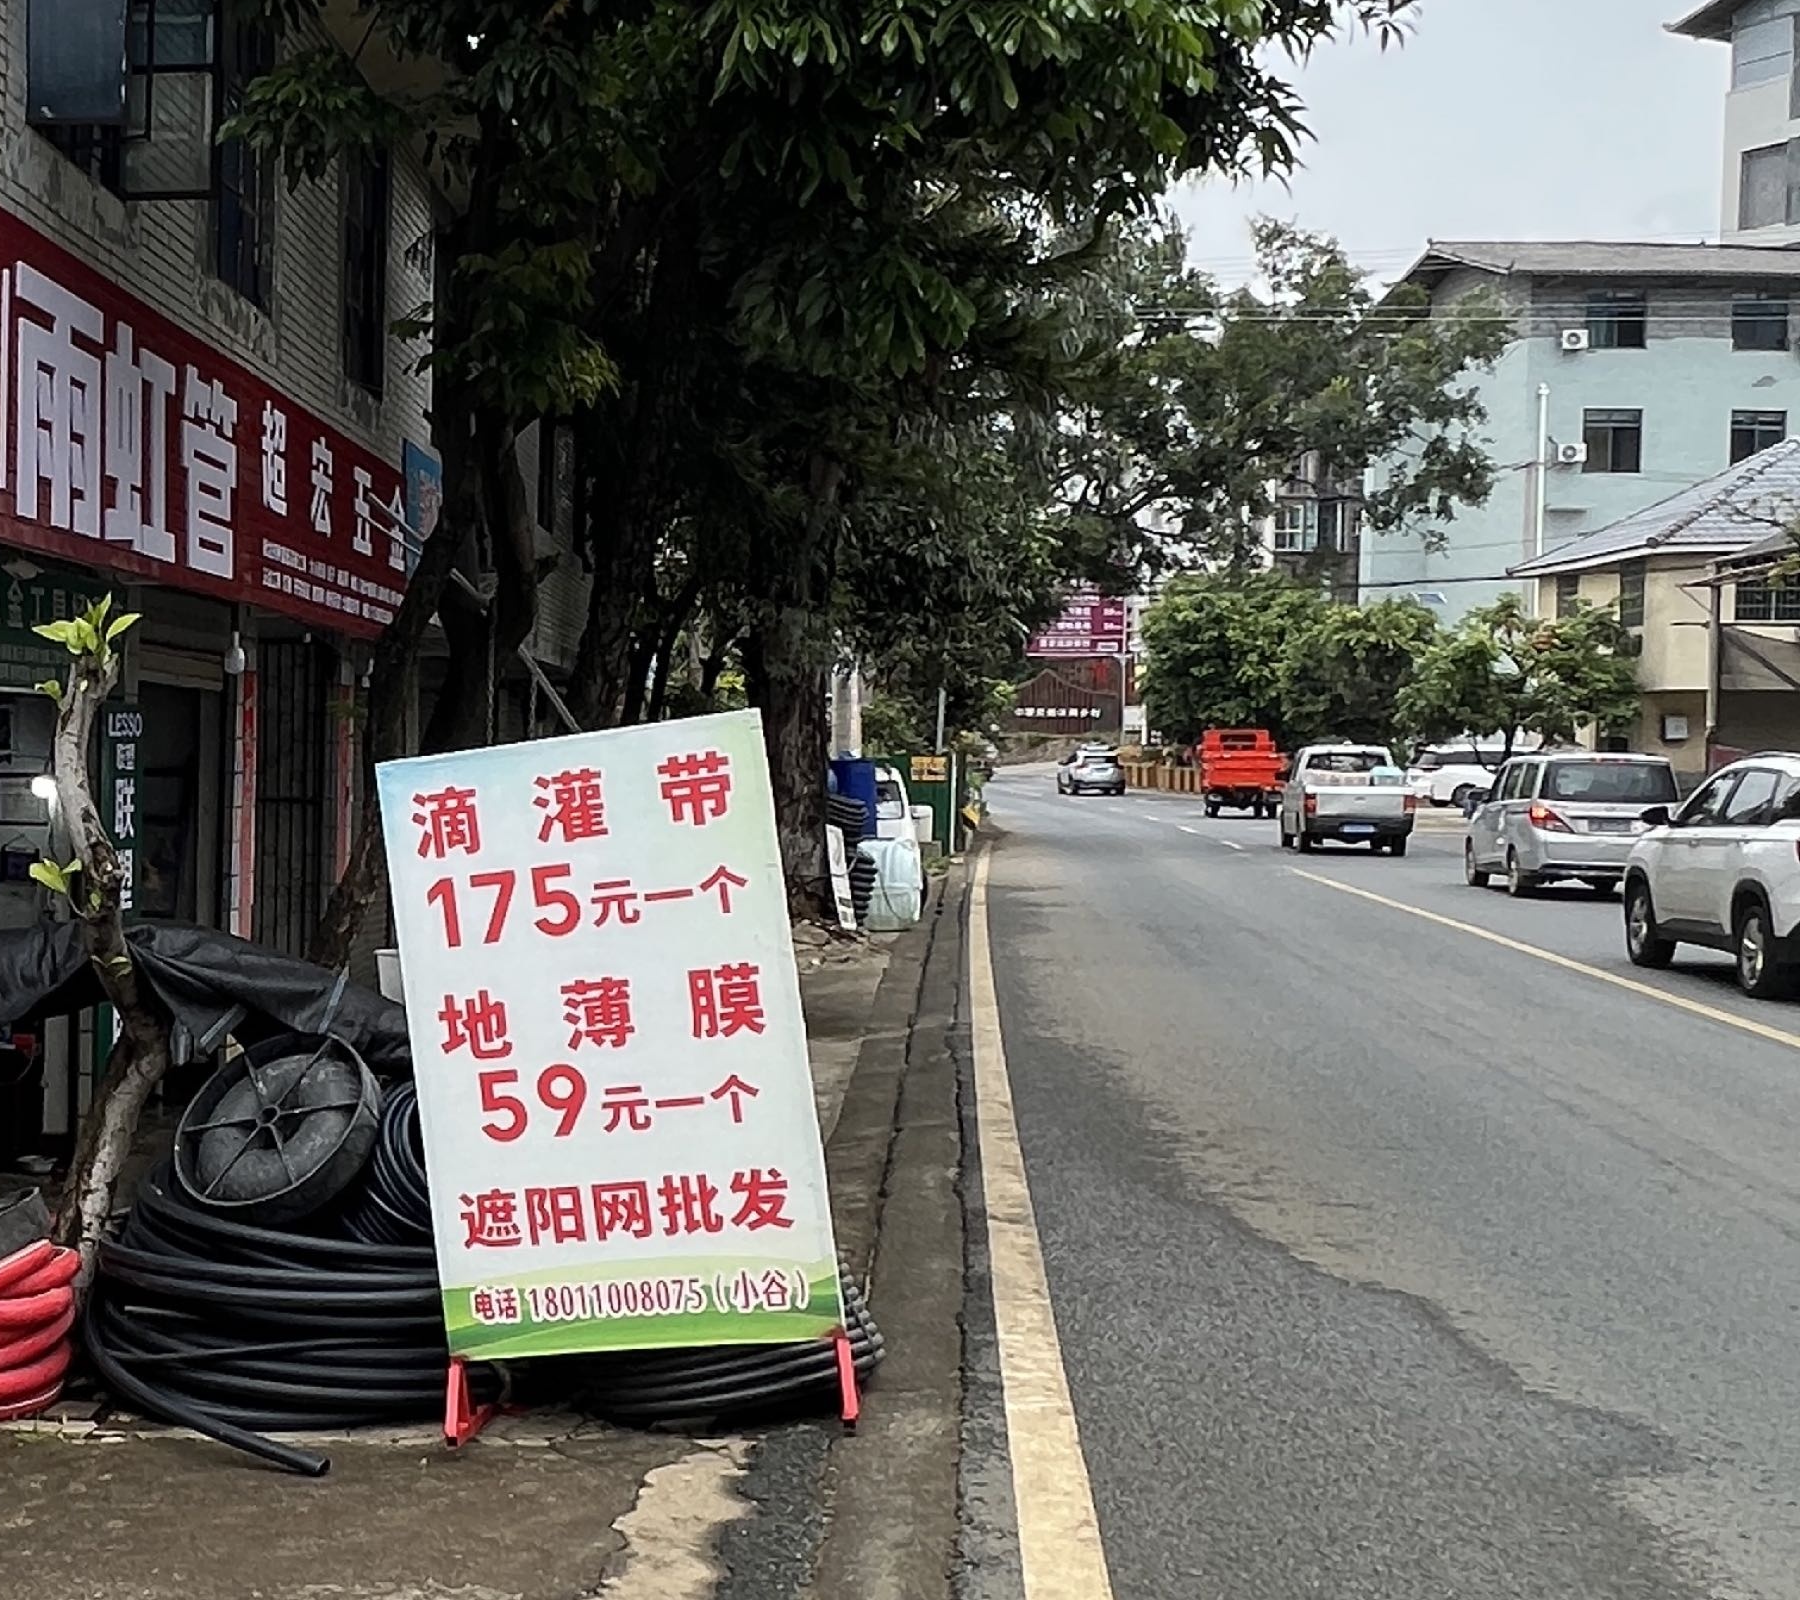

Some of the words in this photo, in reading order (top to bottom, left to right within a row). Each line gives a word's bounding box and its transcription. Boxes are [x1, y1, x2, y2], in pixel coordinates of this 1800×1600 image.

[15, 260, 238, 580] 雨虹管
[108, 712, 143, 738] LESSO
[411, 750, 734, 860] 滴灌带
[426, 863, 749, 950] 175元一个
[438, 962, 767, 1060] 地薄膜
[477, 1064, 760, 1145] 59元一个
[459, 1168, 795, 1250] 遮阳网批发
[473, 1287, 518, 1322] 电话
